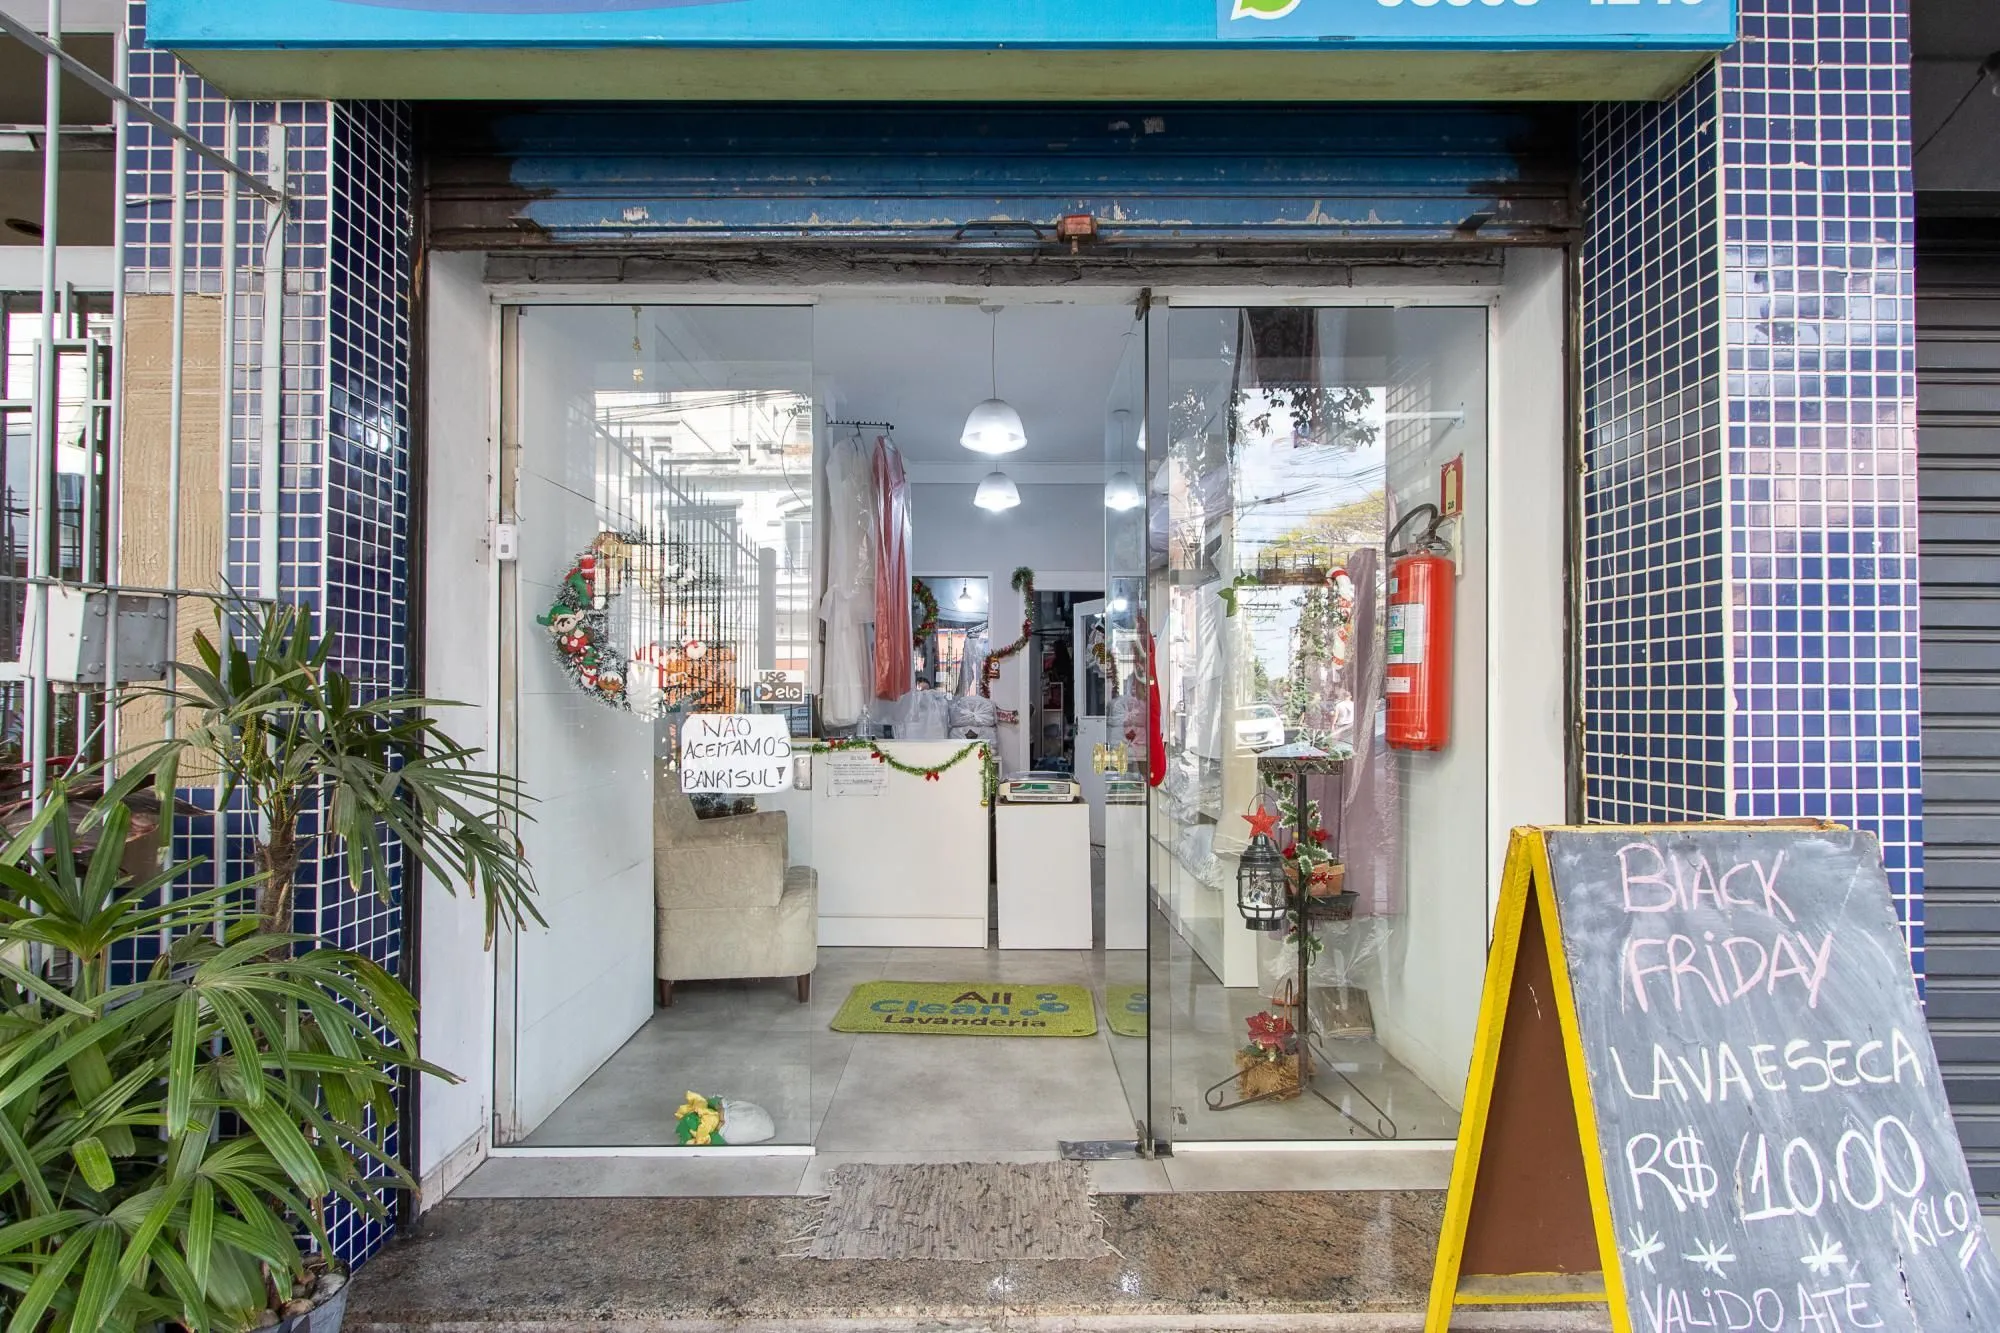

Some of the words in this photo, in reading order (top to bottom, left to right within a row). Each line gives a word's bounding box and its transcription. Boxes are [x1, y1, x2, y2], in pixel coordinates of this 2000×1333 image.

[759, 671, 787, 682] use
[702, 716, 752, 738] NÃO
[951, 992, 1012, 1005] All
[870, 1000, 1010, 1016] Clean
[884, 1014, 1046, 1028] Lavanderia
[1626, 1126, 1718, 1212] R$
